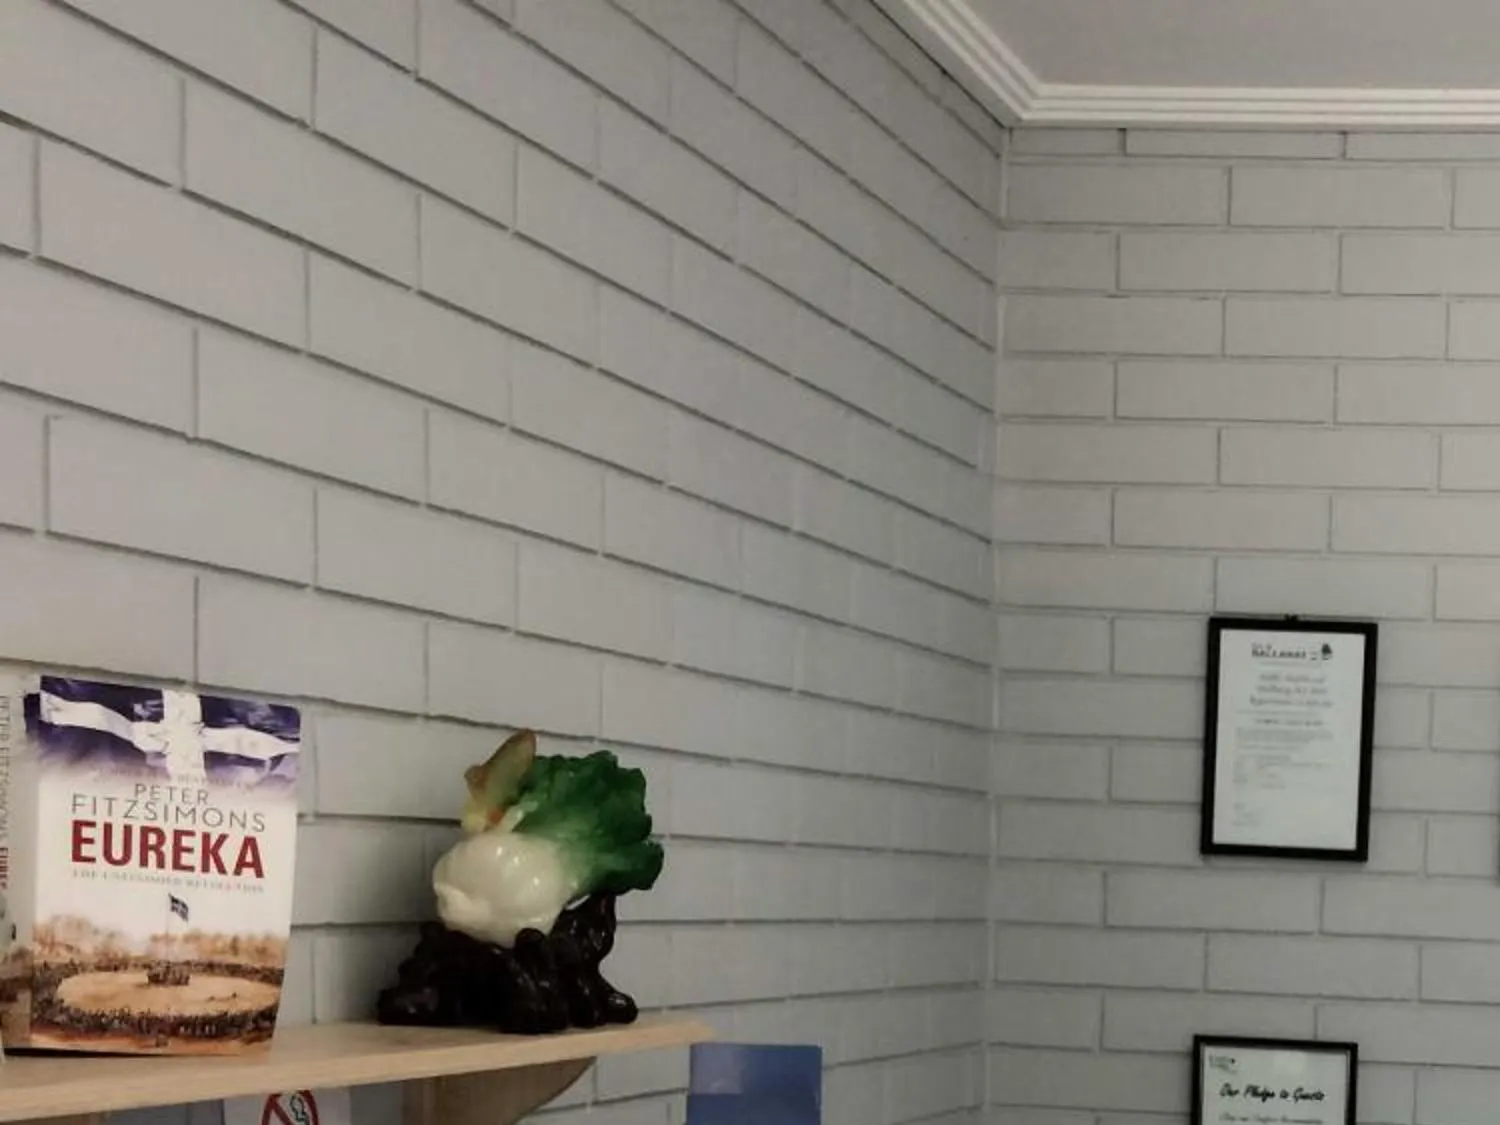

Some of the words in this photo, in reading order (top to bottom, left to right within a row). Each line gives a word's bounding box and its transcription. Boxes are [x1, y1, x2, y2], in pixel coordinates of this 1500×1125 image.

[72, 793, 266, 832] FITZSIMONS
[134, 783, 209, 804] PETER
[71, 820, 264, 879] EUREKA
